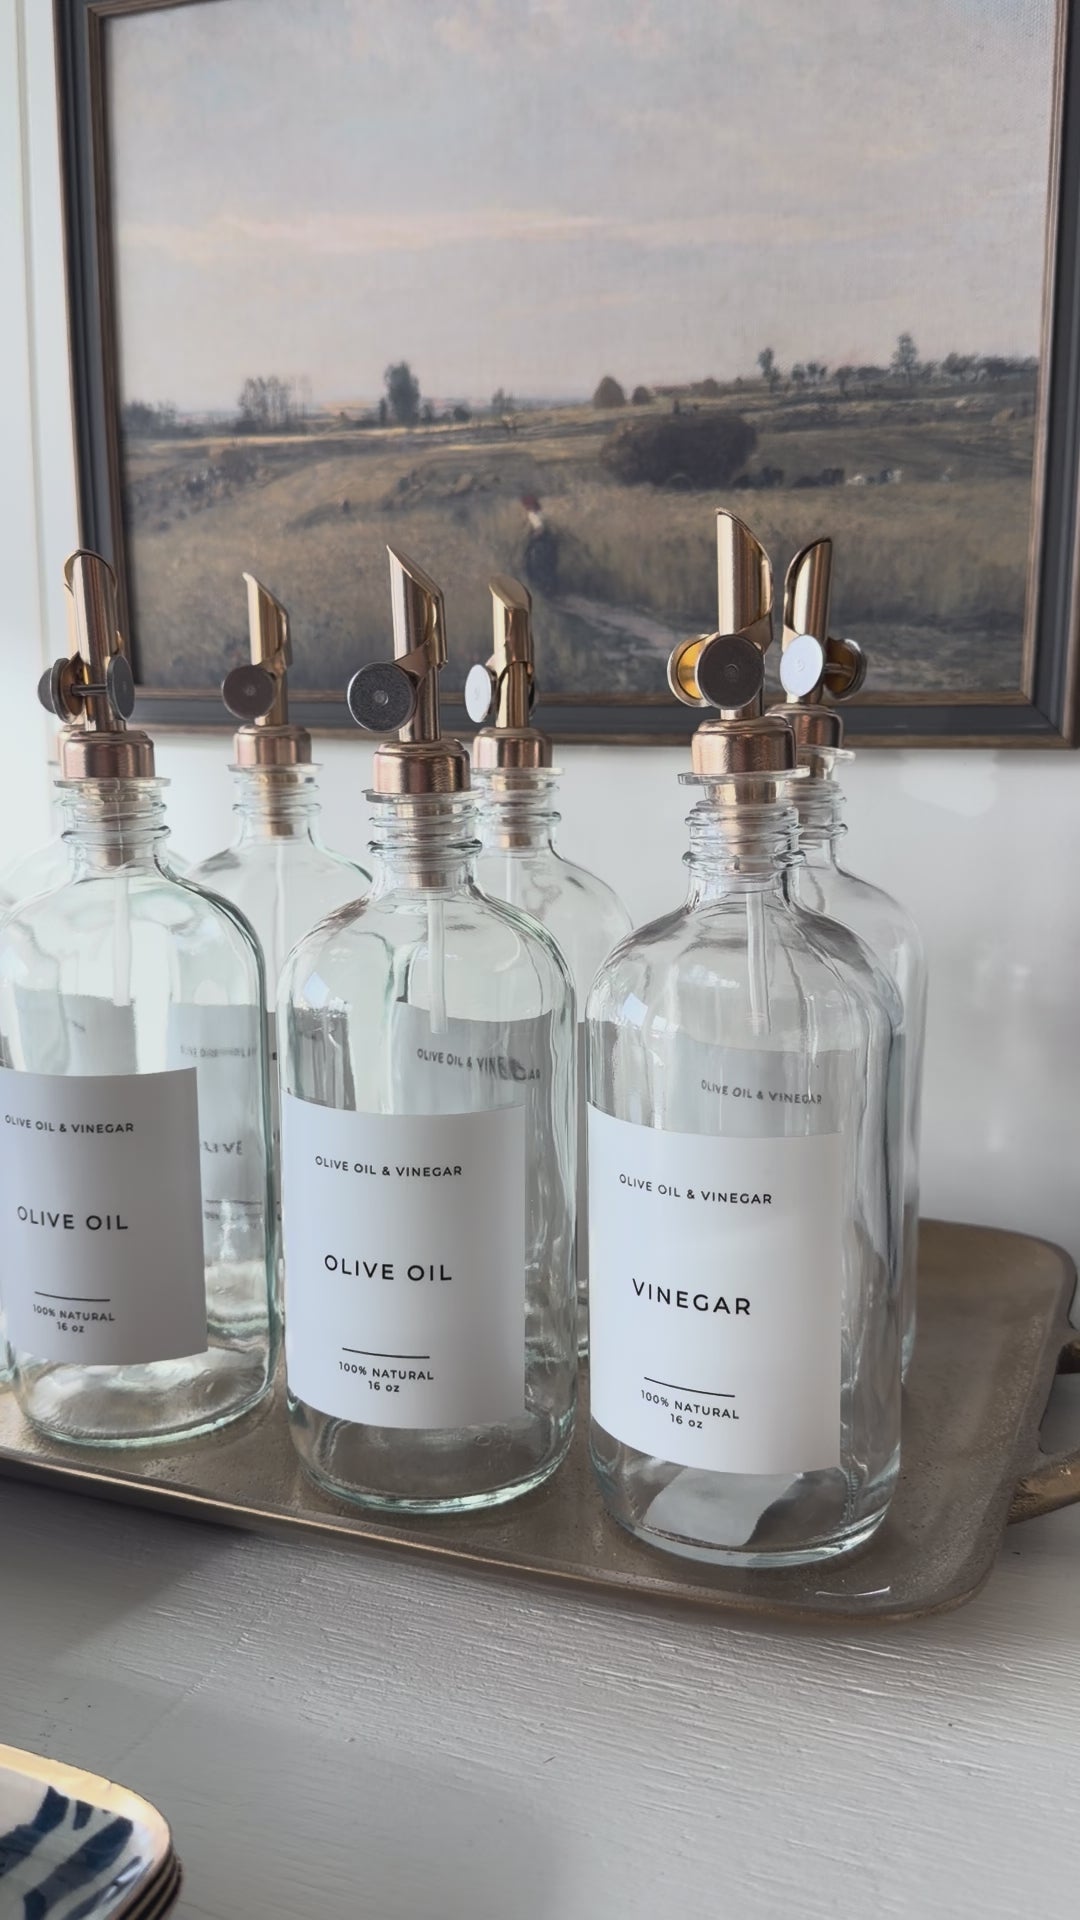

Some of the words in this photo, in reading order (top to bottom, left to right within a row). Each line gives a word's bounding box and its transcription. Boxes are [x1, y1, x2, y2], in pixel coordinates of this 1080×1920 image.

[446, 1053, 463, 1068] OIL
[701, 1079, 728, 1096] OLIVE
[732, 1087, 752, 1099] OIL
[756, 1090, 764, 1100] &
[5, 1114, 32, 1129] OLIVE
[35, 1120, 55, 1132] OIL
[59, 1123, 67, 1133] &
[72, 1123, 134, 1134] VINEGAR
[315, 1155, 349, 1171] OLIVE
[354, 1163, 376, 1175] OIL
[382, 1166, 391, 1176] &
[396, 1165, 463, 1177] VINEGAR
[619, 1173, 652, 1192] OLIVE
[658, 1184, 681, 1198] OIL
[686, 1189, 695, 1200] &
[701, 1190, 772, 1204] VINEGAR
[17, 1205, 75, 1230] OLIVE
[86, 1214, 128, 1230] OIL
[324, 1254, 394, 1280] OLIVE
[407, 1264, 452, 1281] OIL
[632, 1278, 751, 1315] VINEGAR
[33, 1303, 56, 1317] 100%
[59, 1310, 115, 1322] NATURAL
[56, 1321, 68, 1331] 16
[339, 1361, 367, 1376] 100%
[372, 1367, 434, 1380] NATURAL
[368, 1380, 380, 1391] 16
[385, 1384, 400, 1393] oz
[641, 1389, 670, 1408] 100%
[674, 1400, 739, 1419] NATURAL
[670, 1413, 683, 1425] 16
[688, 1418, 703, 1429] oz
